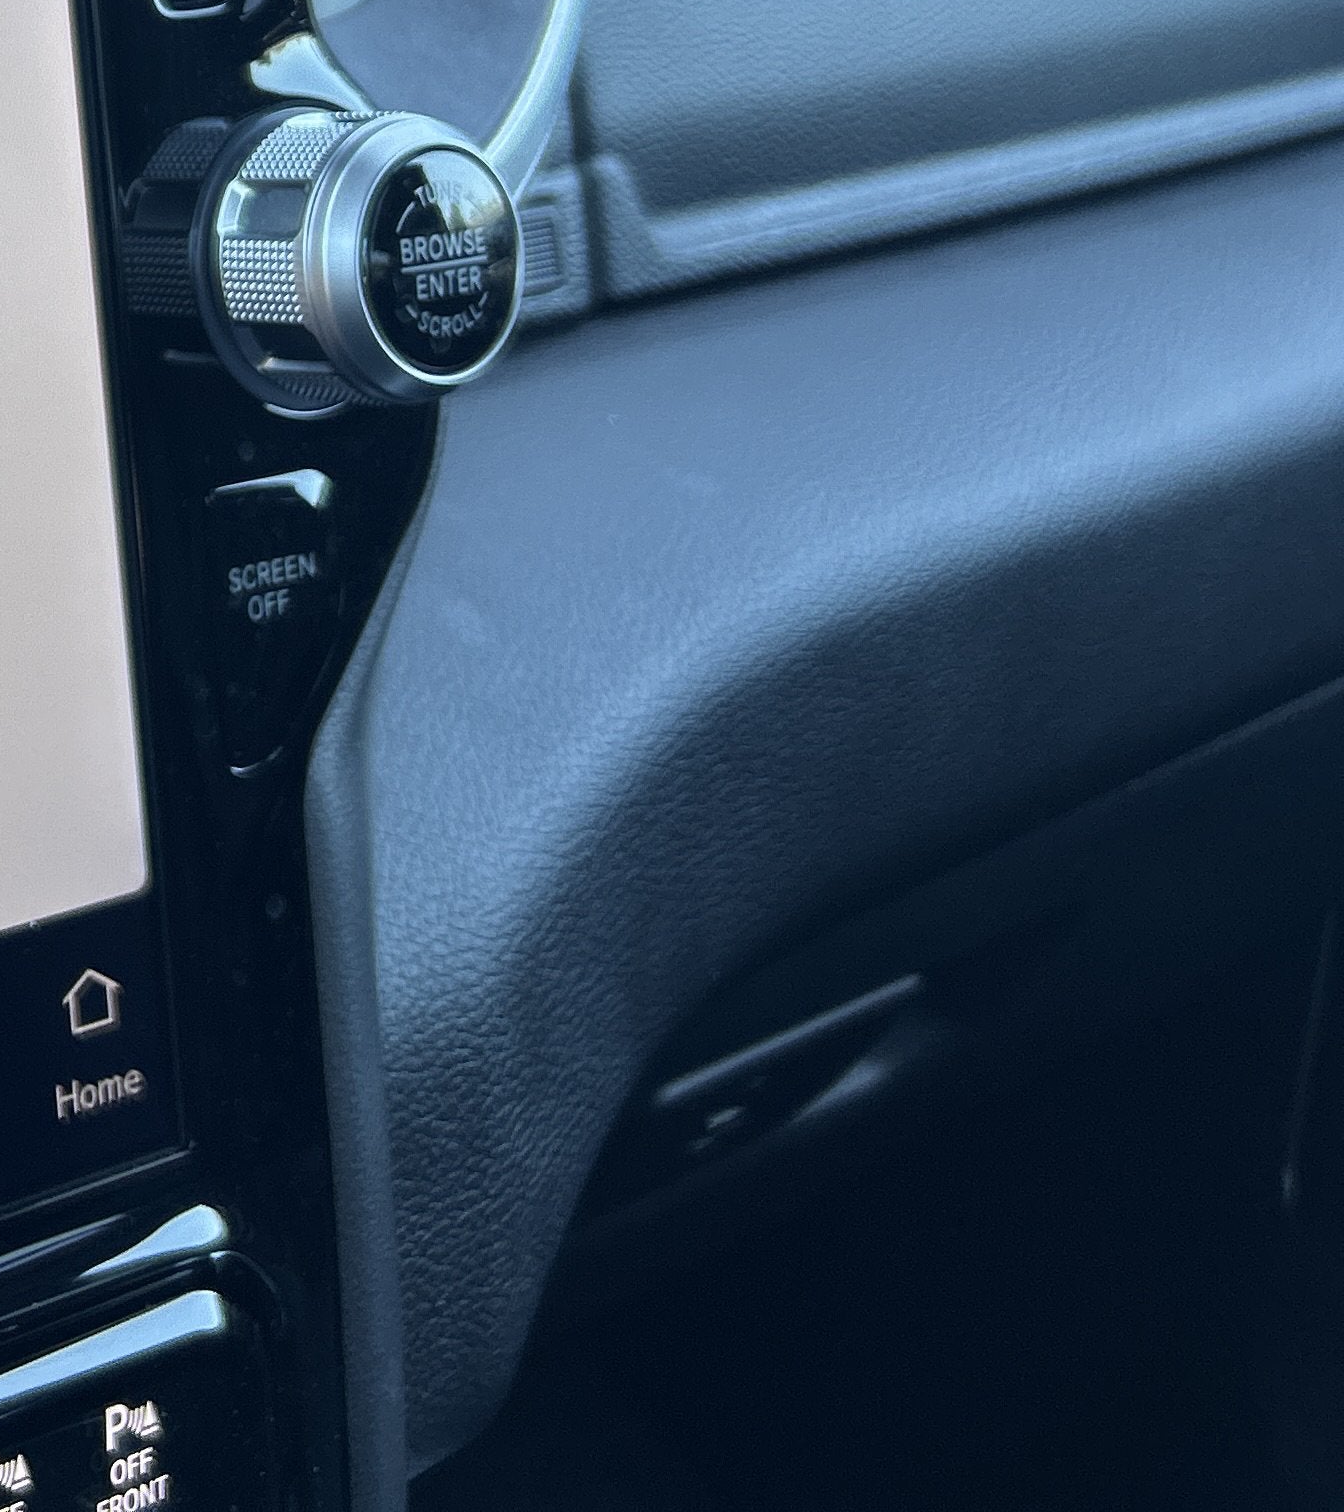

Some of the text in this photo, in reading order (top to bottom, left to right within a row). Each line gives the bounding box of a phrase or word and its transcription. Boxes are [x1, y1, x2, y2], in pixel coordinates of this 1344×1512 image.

[400, 226, 488, 265] BROWSE
[416, 265, 483, 301] ENTER
[417, 302, 483, 337] SCROLL
[228, 552, 318, 594] SCREEN
[247, 589, 291, 622] OFF
[55, 1066, 146, 1121] Home
[109, 1446, 155, 1486] OFF
